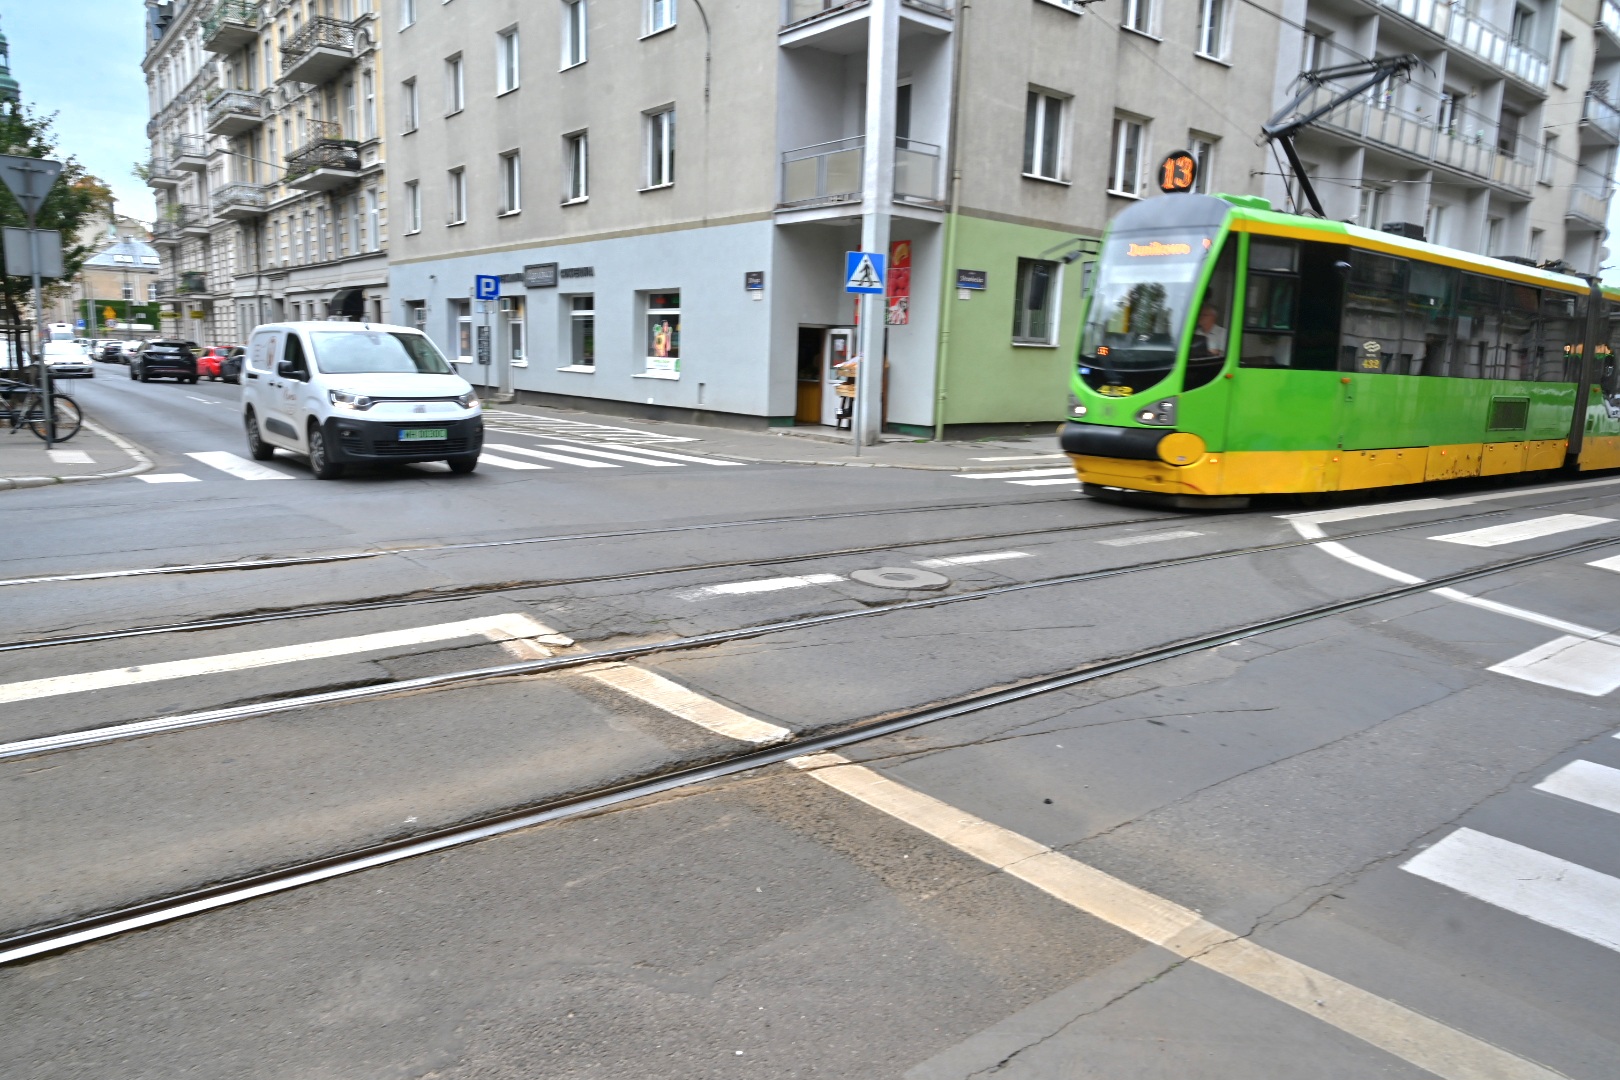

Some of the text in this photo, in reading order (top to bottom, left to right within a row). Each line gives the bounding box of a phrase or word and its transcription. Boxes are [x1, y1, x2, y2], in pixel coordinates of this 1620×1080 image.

[1161, 156, 1194, 189] 13
[1127, 241, 1191, 257] Junikowo
[480, 277, 496, 297] P
